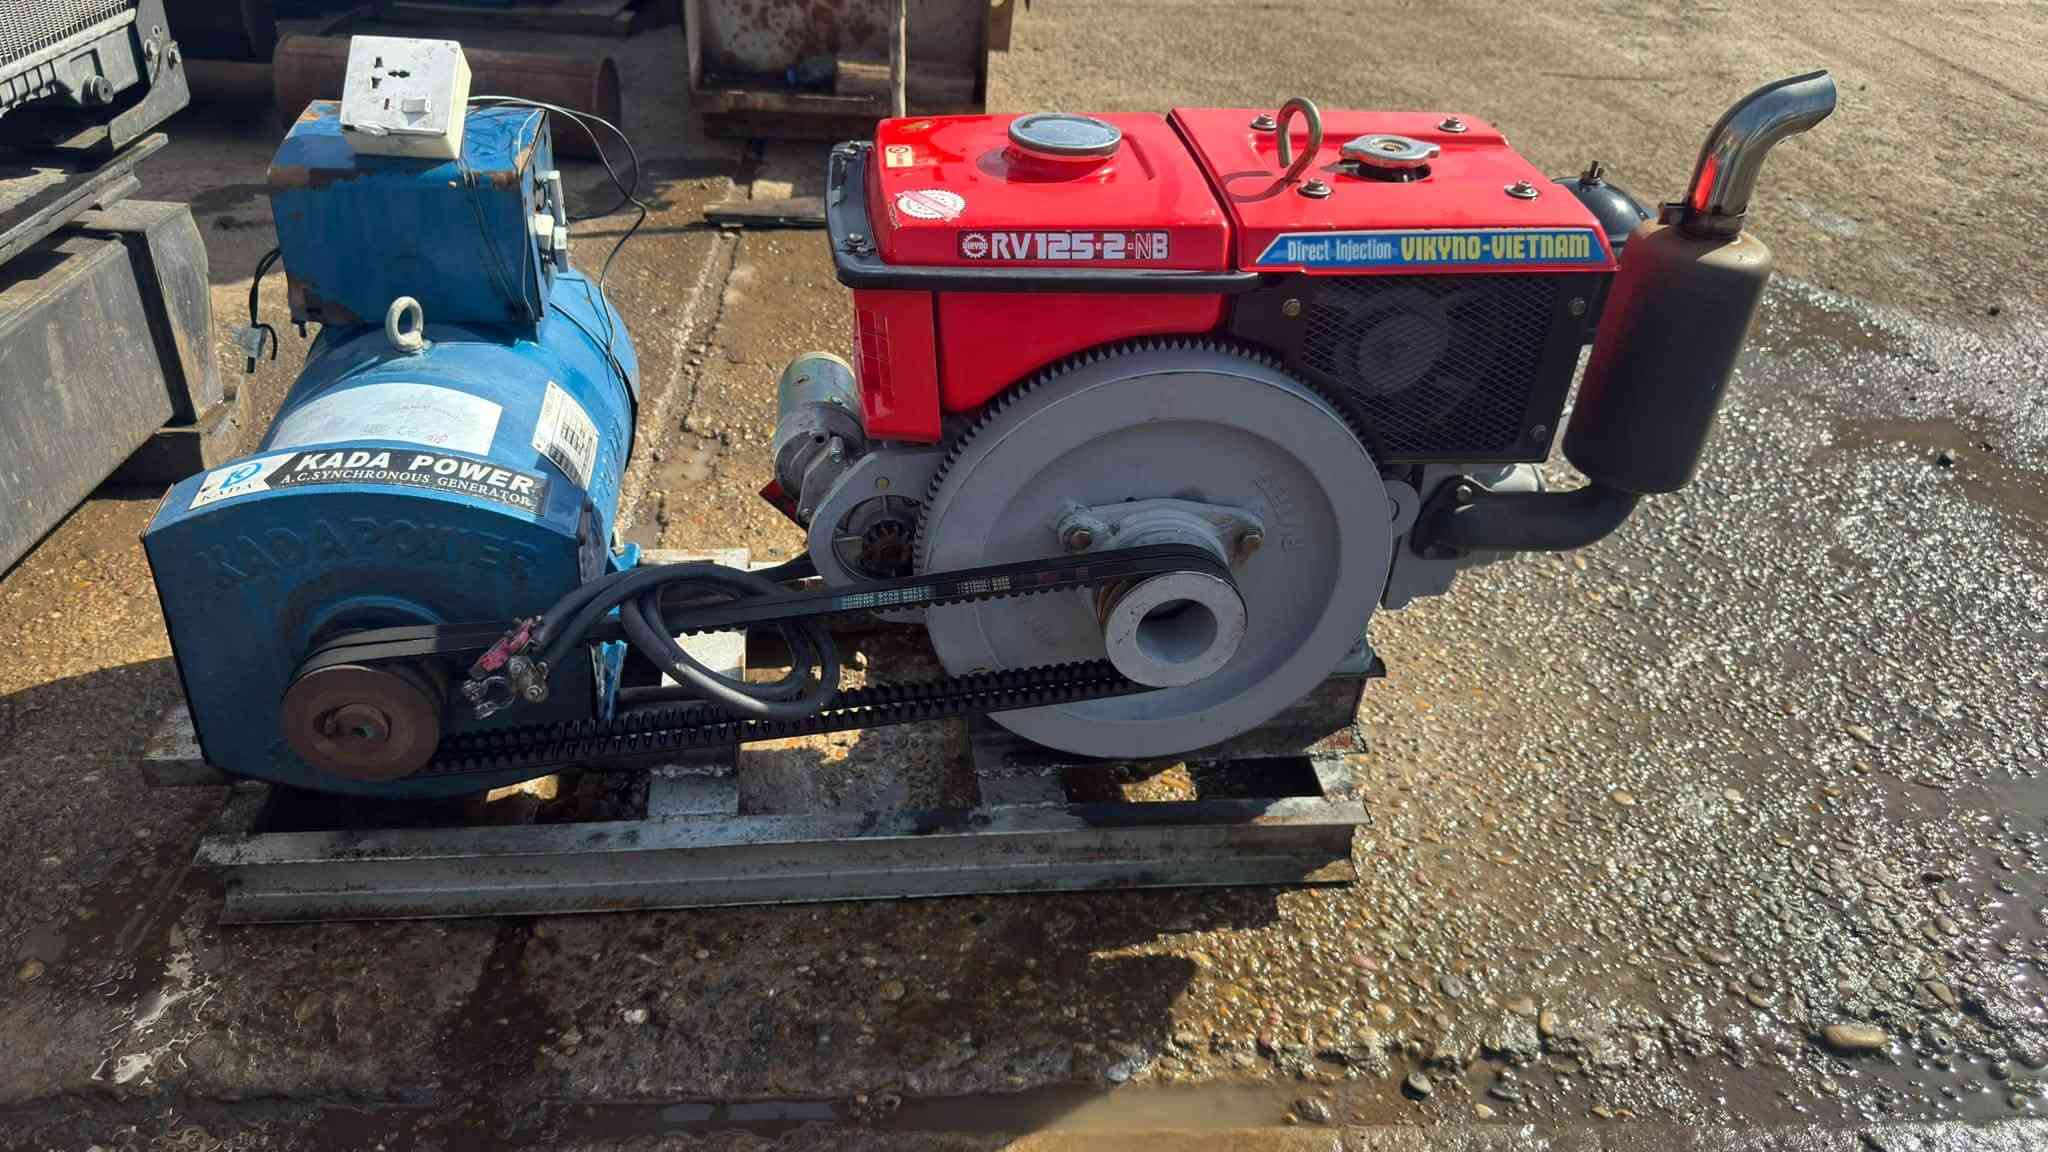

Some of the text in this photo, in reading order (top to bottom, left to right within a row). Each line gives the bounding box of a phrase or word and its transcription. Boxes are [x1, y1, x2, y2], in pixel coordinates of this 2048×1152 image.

[1287, 234, 1591, 262] Direct Injection VIKYNO-VIETNAM
[294, 451, 535, 495] KADA POWER
[437, 476, 530, 506] GENERATOR
